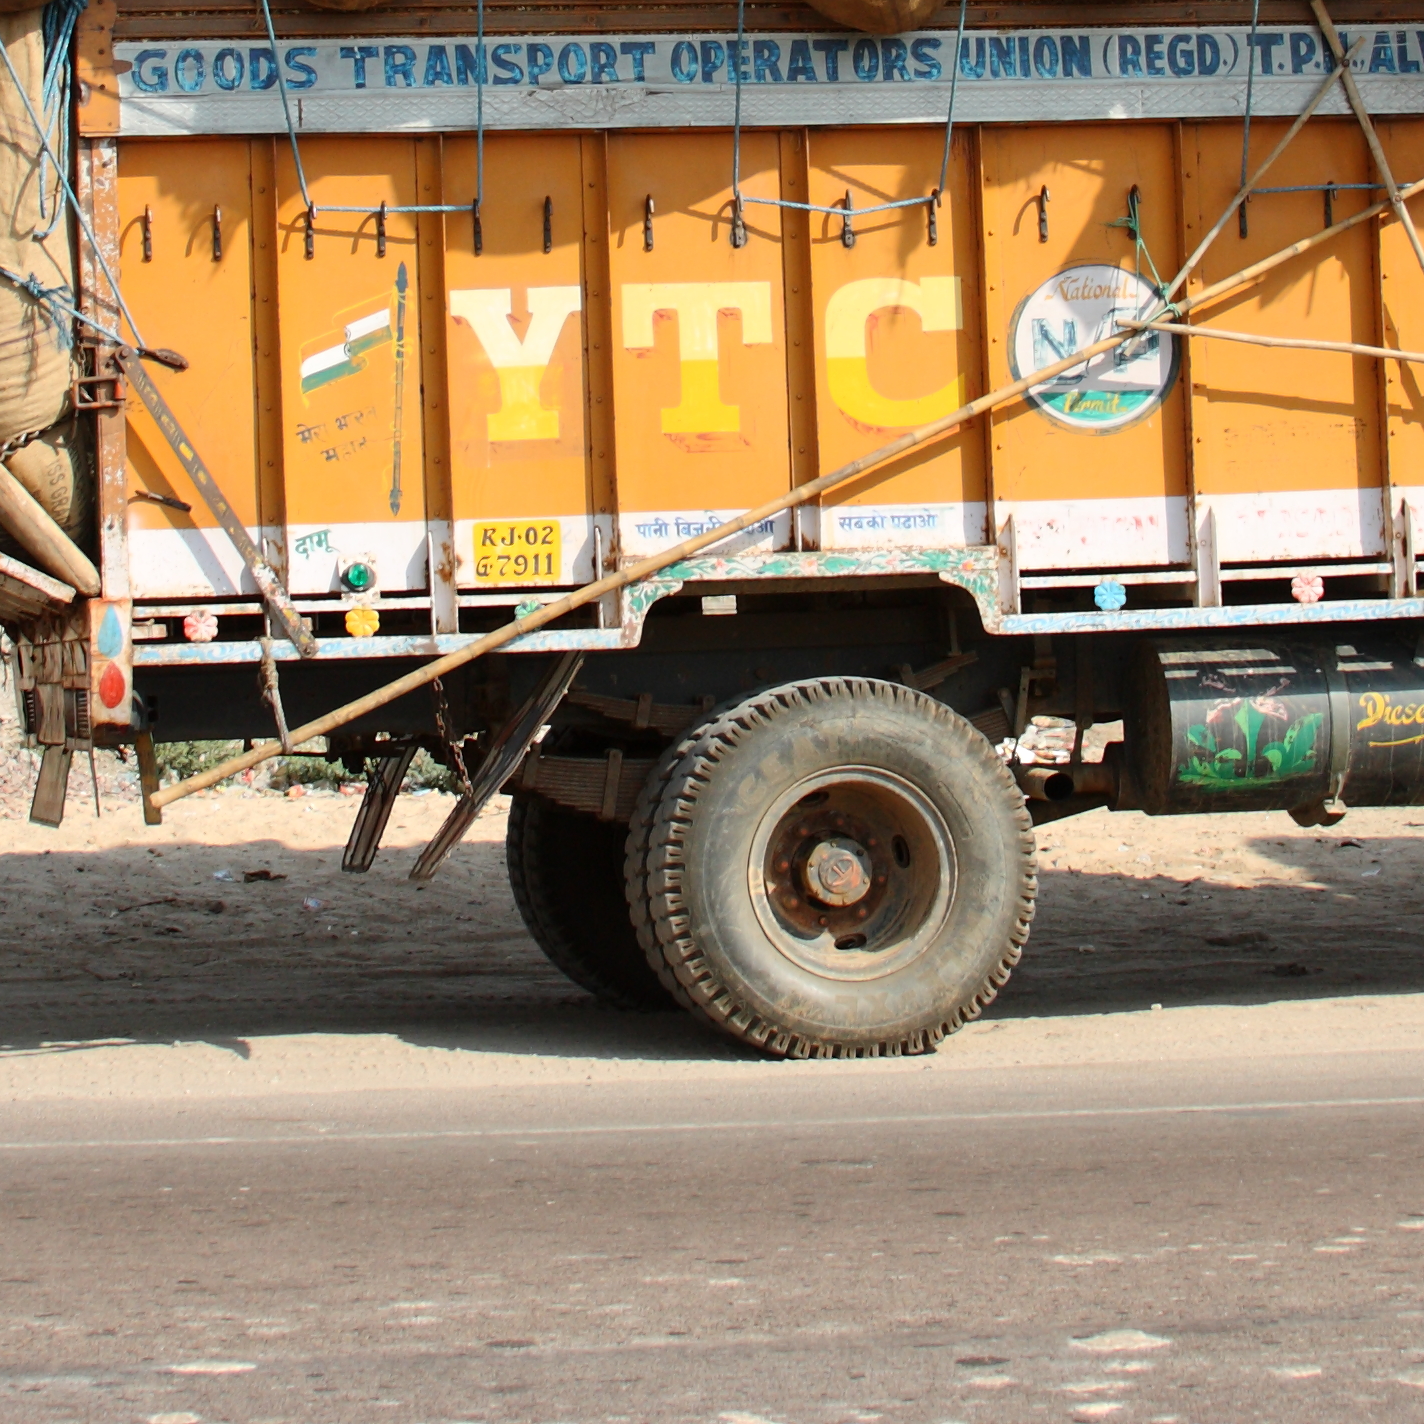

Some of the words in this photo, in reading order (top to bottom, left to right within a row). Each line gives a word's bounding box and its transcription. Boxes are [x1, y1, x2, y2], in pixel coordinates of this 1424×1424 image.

[131, 47, 318, 93] GOODS
[339, 40, 655, 90] TRANSPORT
[670, 36, 943, 84] OPERATORS
[960, 33, 1093, 80] UNION
[1103, 32, 1239, 77] (REGD.)
[1051, 276, 1129, 303] National
